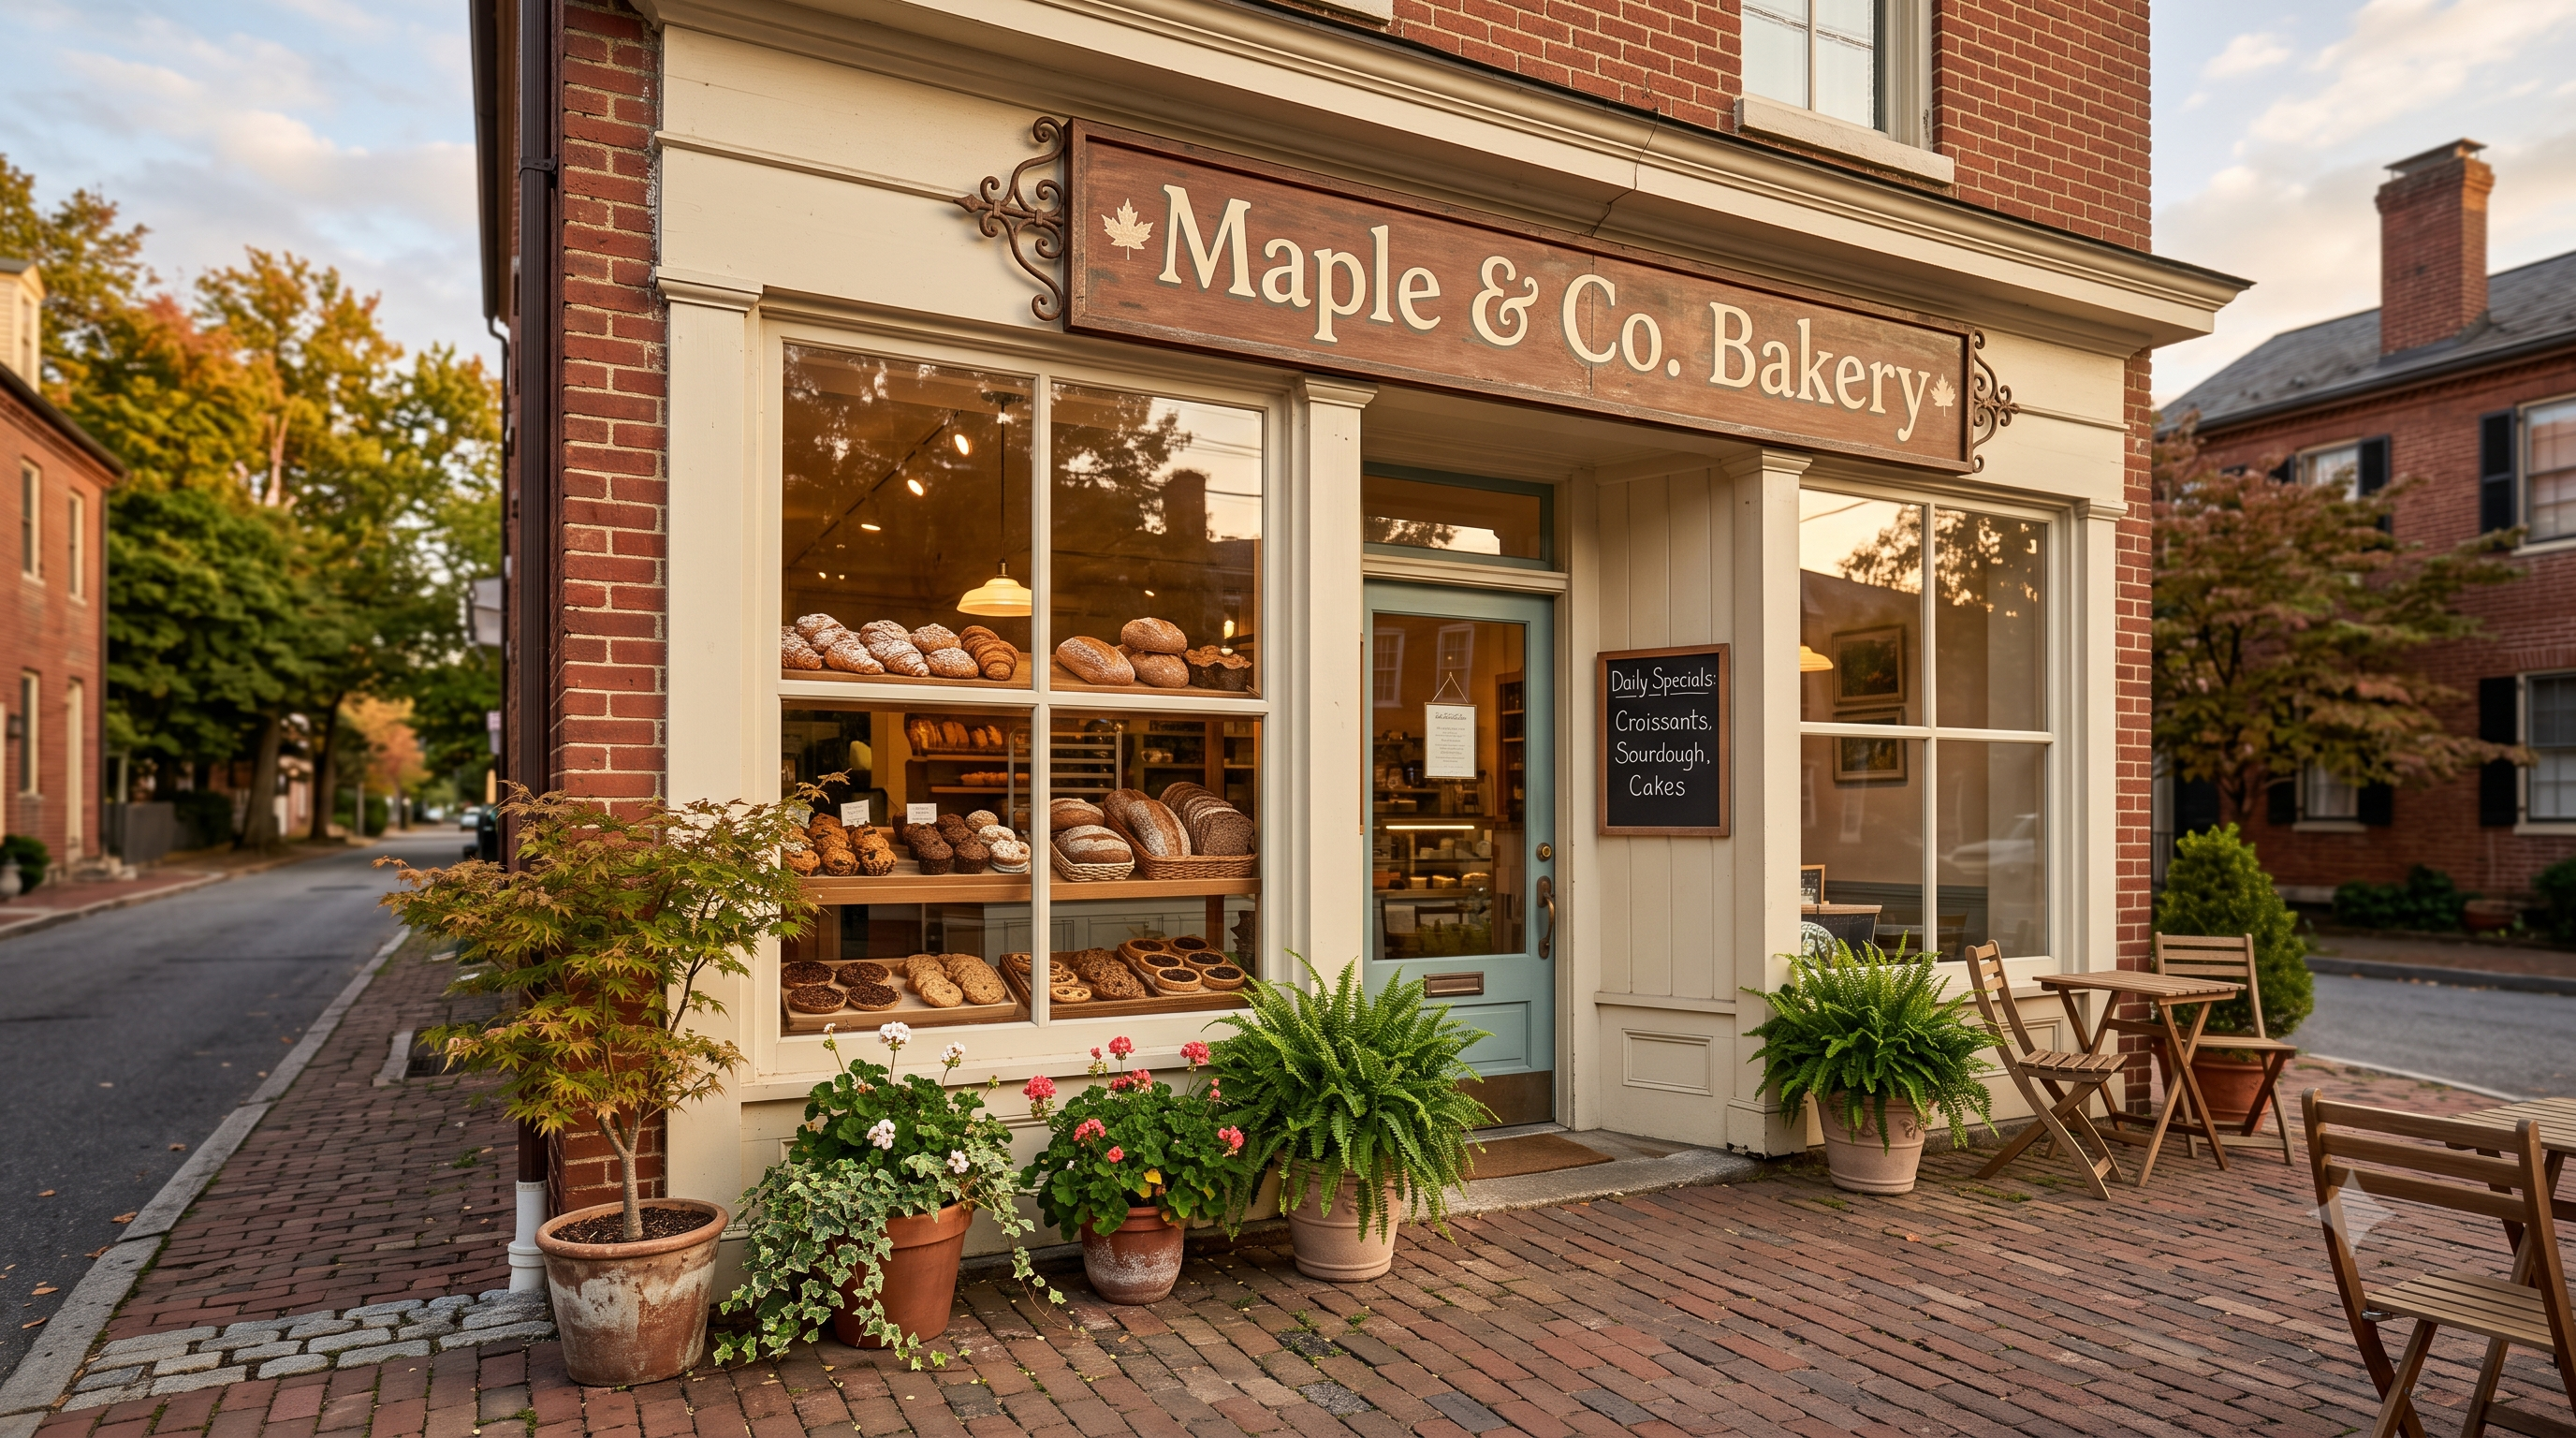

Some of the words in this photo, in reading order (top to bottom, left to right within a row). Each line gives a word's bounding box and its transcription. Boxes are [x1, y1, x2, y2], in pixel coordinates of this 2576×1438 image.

[1158, 183, 1442, 344] Maple
[1471, 256, 1539, 346] &
[1562, 273, 1681, 377] Co.
[1709, 301, 1931, 443] Bakery
[1612, 668, 1648, 697] Daily
[1652, 667, 1717, 697] Specials:
[1616, 709, 1712, 732] Croissants,
[1615, 741, 1711, 771] Sourdough,
[1629, 774, 1686, 797] Cakes
